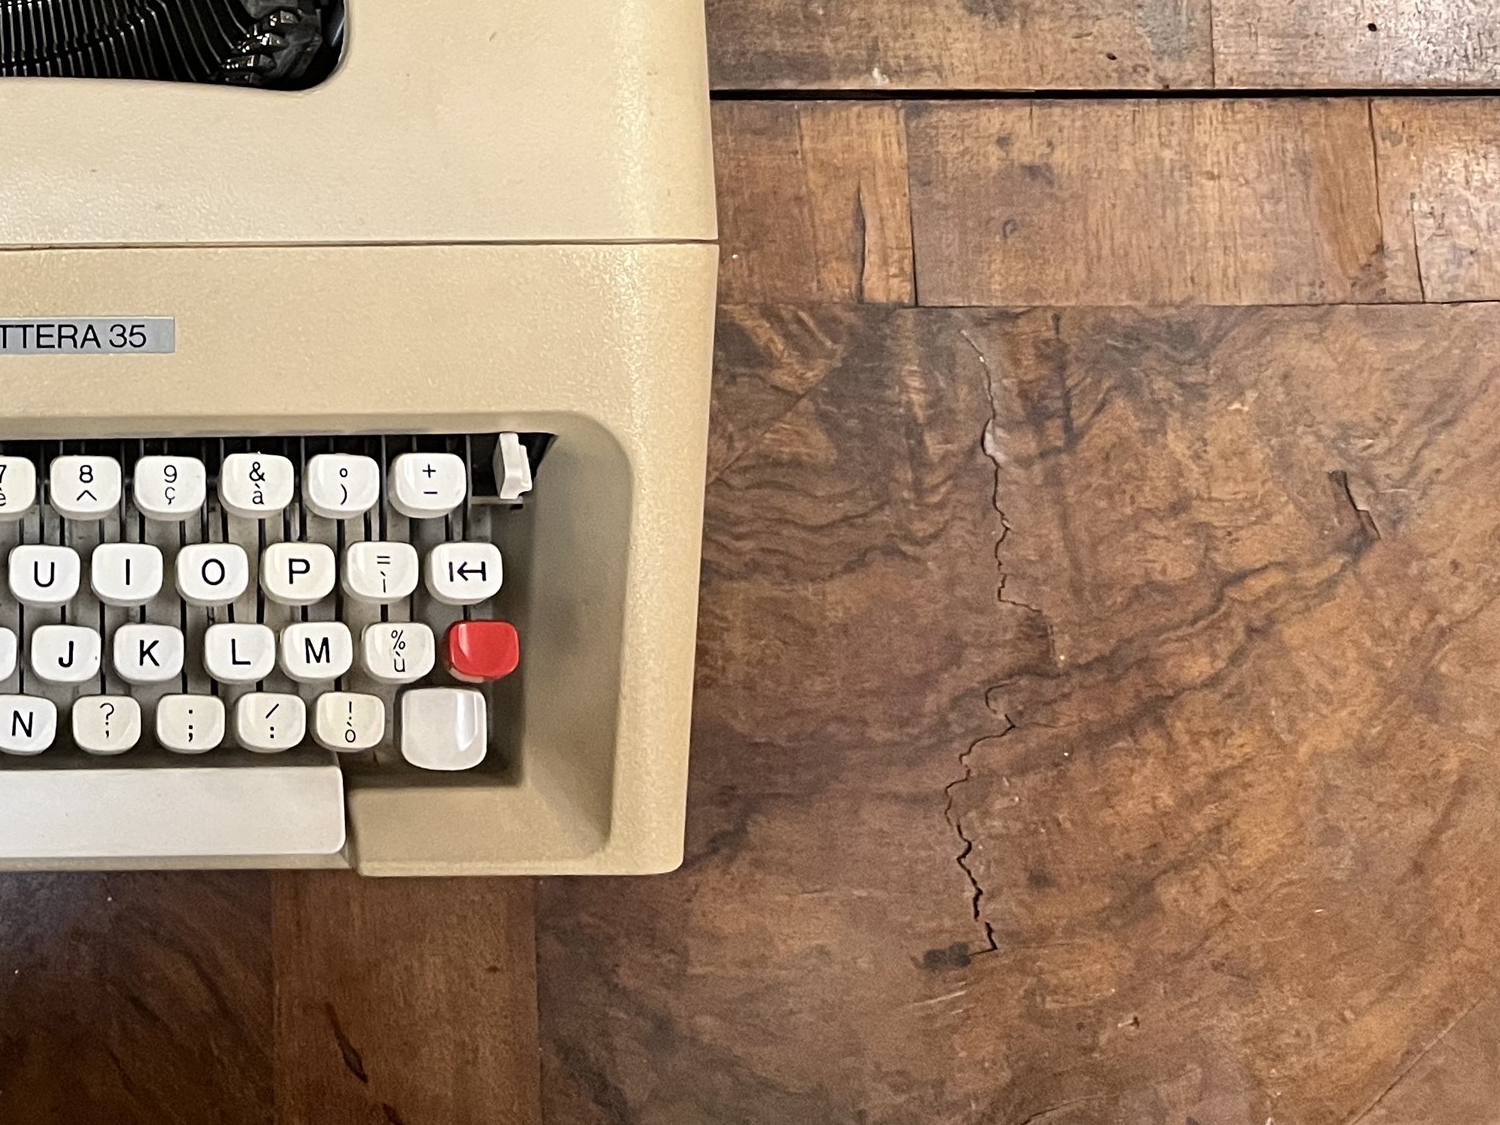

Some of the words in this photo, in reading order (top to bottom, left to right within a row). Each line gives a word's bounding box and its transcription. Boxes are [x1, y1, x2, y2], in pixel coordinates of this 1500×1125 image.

[108, 323, 147, 349] 35
[78, 464, 94, 484] 8
[163, 464, 178, 484] 9
[248, 461, 266, 482] &
[422, 463, 437, 479] +
[164, 486, 176, 505] ç
[252, 483, 265, 505] à
[340, 483, 348, 506] )
[33, 560, 55, 588] U
[201, 558, 226, 586] O
[288, 558, 311, 585] P
[304, 636, 331, 664] M
[390, 629, 406, 650] %
[58, 640, 75, 668] J
[139, 639, 160, 667] K
[230, 638, 252, 666] L
[393, 652, 406, 673] ù
[11, 710, 34, 738] N
[99, 702, 115, 726] ?
[344, 721, 357, 744] ò
